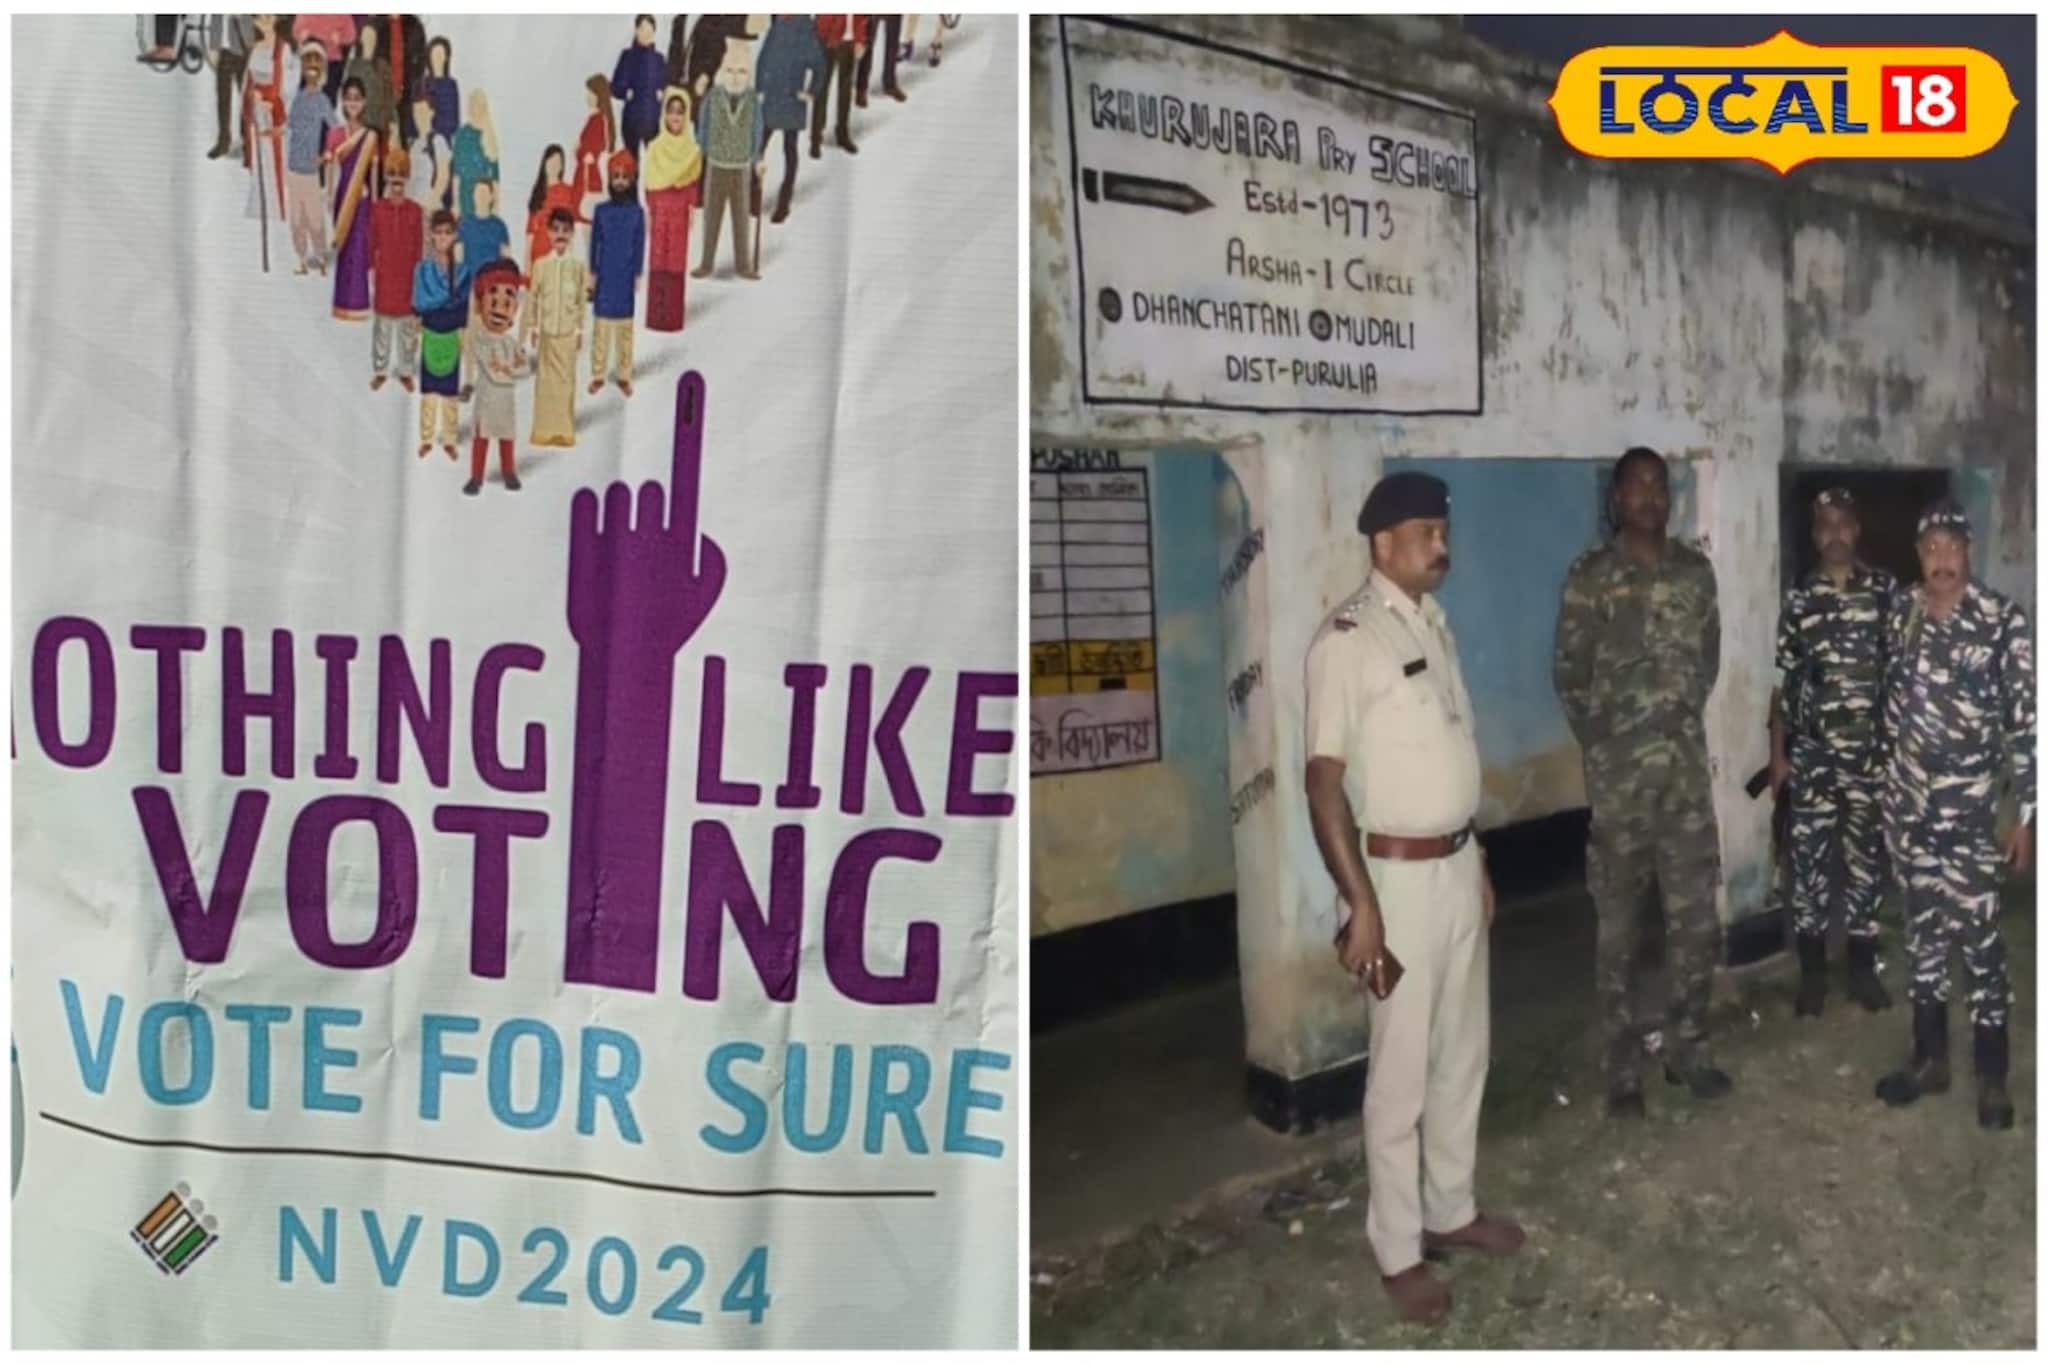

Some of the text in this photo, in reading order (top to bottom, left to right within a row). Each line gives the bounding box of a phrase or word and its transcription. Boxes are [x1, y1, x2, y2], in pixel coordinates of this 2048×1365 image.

[1369, 134, 1476, 198] SCHOOL
[1132, 291, 1415, 350] DHANCHATANI MUDALI
[1226, 354, 1378, 395] DIST-PURULIA
[11, 616, 1018, 817] OTHING LIKE
[59, 979, 1012, 1158] VOTE FOR SURE
[278, 1206, 771, 1325] NVD2024
